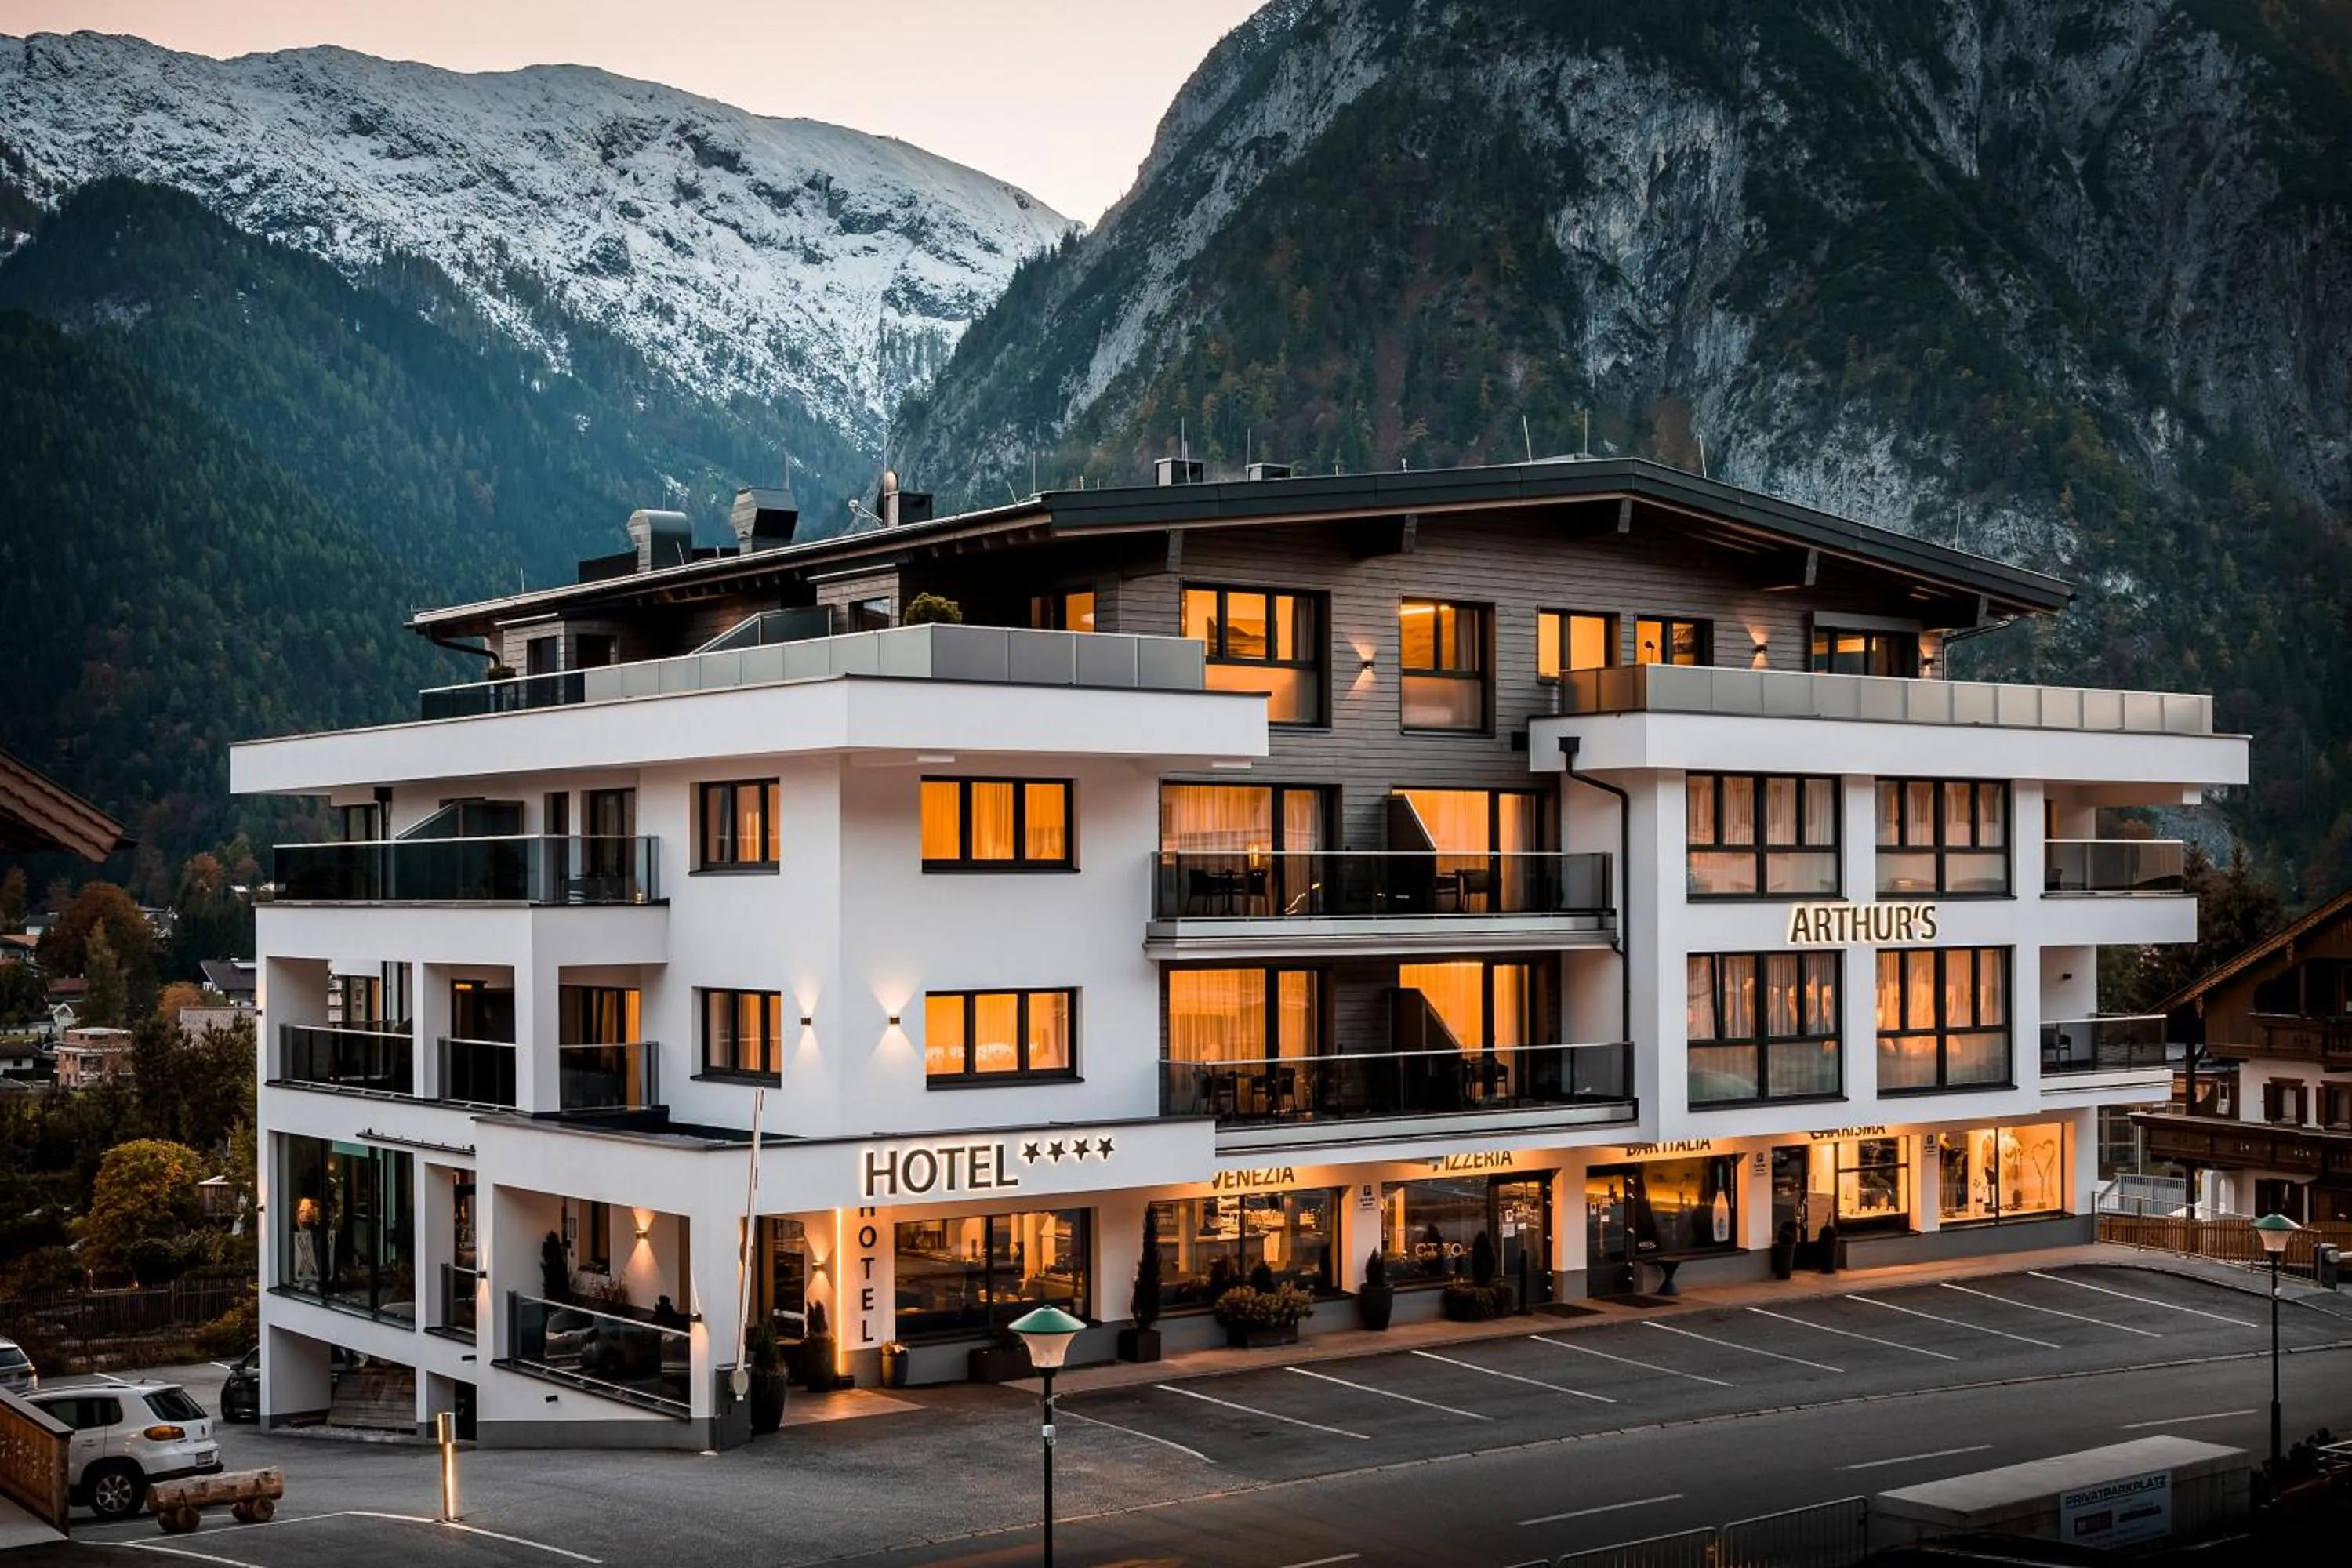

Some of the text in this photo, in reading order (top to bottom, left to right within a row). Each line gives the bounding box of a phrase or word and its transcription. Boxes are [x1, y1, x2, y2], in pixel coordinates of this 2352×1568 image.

[1791, 906, 1937, 942] ARTHUR'S
[866, 1144, 1018, 1196] HOTEL
[1433, 1150, 1512, 1171] IZZERIA
[1212, 1167, 1295, 1189] VENEZIA
